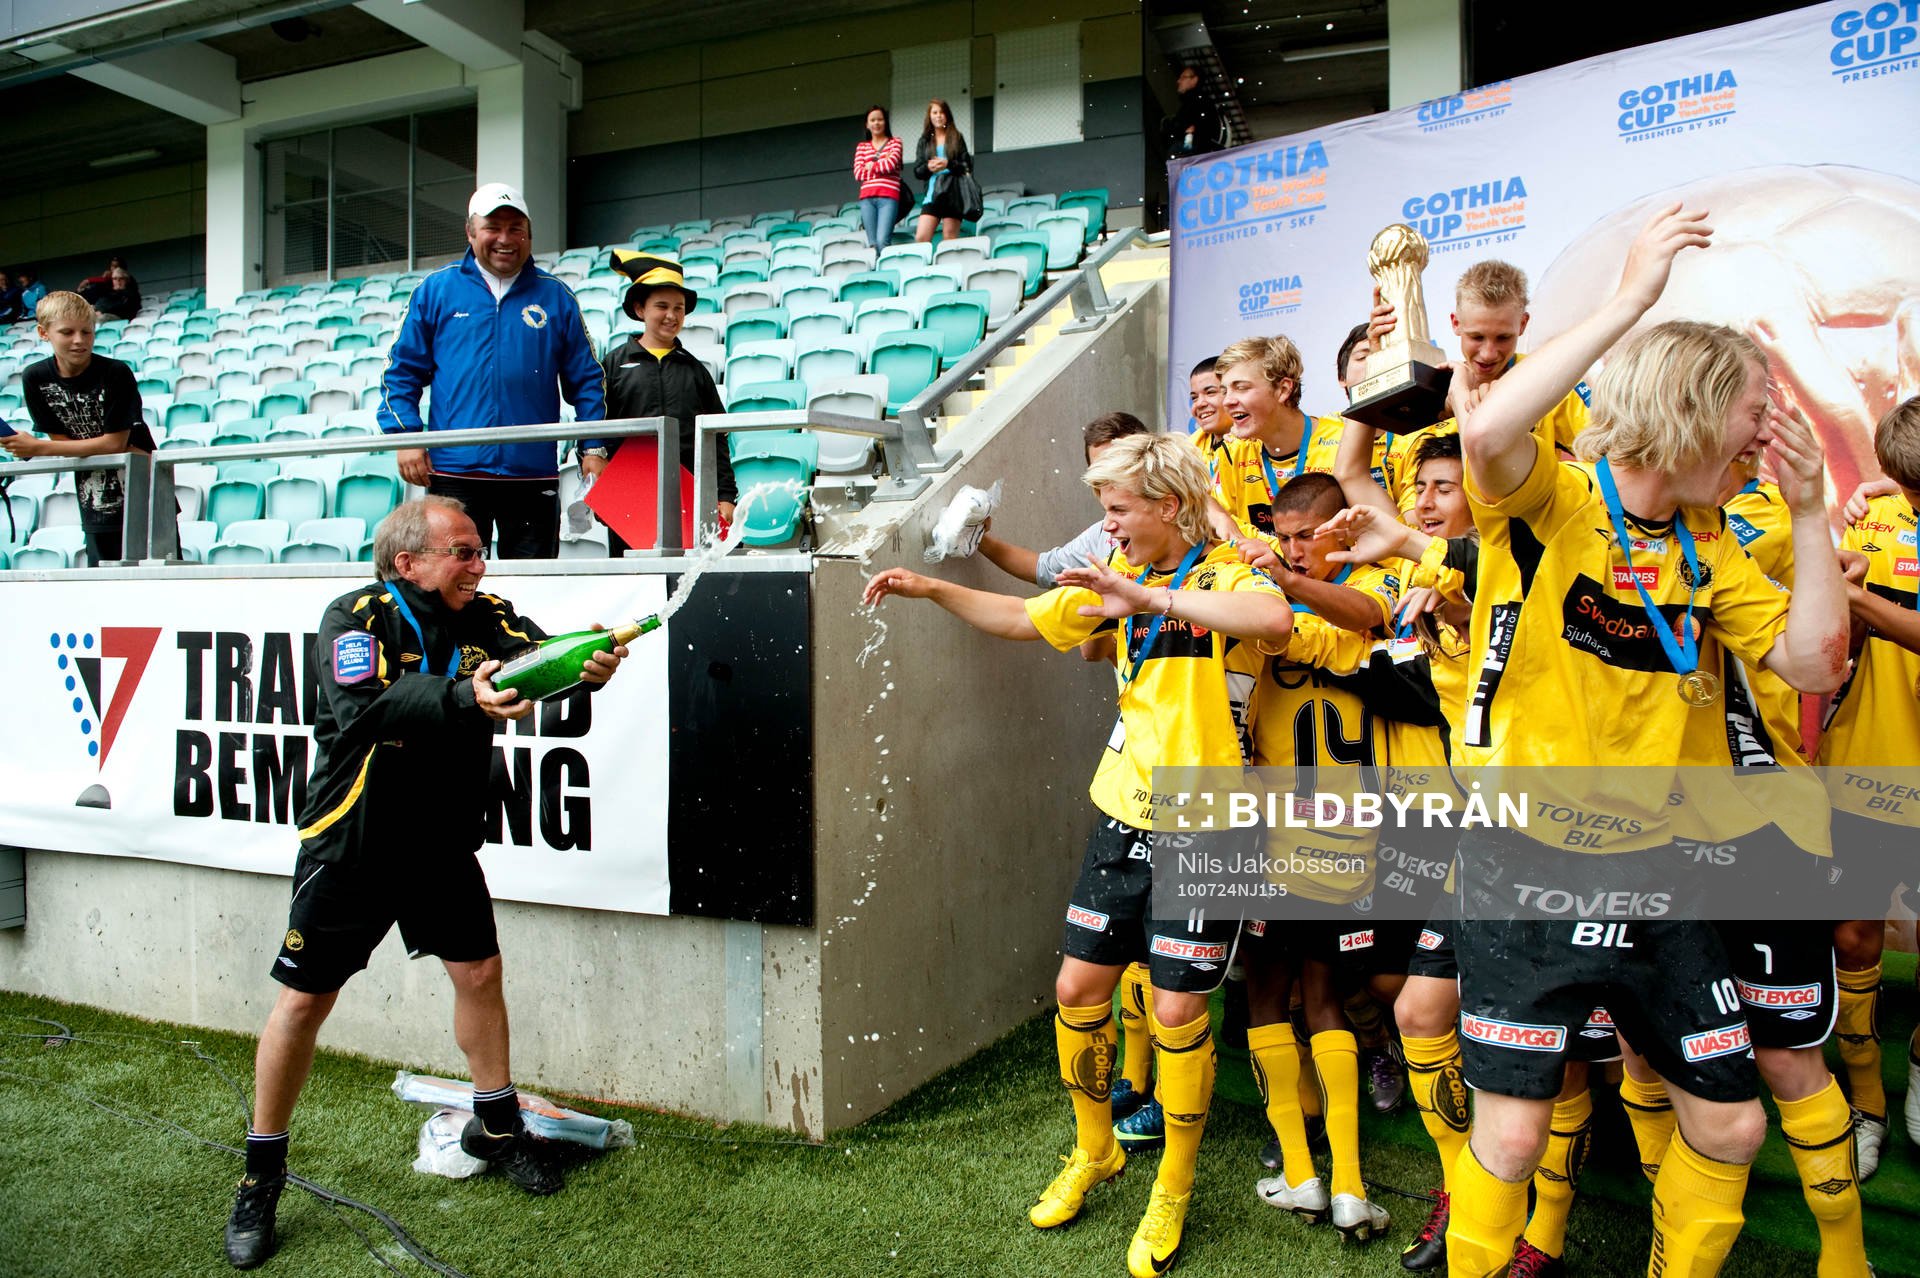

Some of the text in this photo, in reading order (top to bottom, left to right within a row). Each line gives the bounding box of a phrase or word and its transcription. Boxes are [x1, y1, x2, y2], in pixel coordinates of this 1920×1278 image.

[1831, 1, 1920, 38] GOT
[1830, 26, 1918, 67] CUP
[1842, 60, 1919, 84] PRESENTE
[1618, 69, 1737, 110] GOTHIA
[1418, 97, 1464, 122] CUP
[1618, 103, 1676, 131] CUP
[1713, 102, 1735, 111] Cup
[1625, 117, 1728, 144] PRESENTED BY SKF
[1177, 140, 1329, 197] GOTHIA
[1252, 171, 1327, 198] The World
[1297, 191, 1326, 204] Cup
[1402, 176, 1527, 219] GOTHIA
[1178, 189, 1249, 230] CUP
[1465, 211, 1486, 221] The
[1502, 214, 1525, 225] Cup
[1187, 214, 1316, 249] PRESENTED BY SKF
[1408, 214, 1462, 240] UP
[1430, 232, 1518, 255] SENTED BY SKF
[1239, 275, 1303, 298] GOTHIA
[1239, 295, 1269, 312] CUP
[1294, 699, 1381, 800] 14
[1844, 772, 1920, 802] TOVEK
[1536, 801, 1643, 834] TOVEKS
[1866, 796, 1904, 814] BIL
[1563, 829, 1605, 848] BIL
[1382, 871, 1417, 897] BIL
[1513, 883, 1672, 918] TOVEKS
[1069, 908, 1102, 928] -BYGG
[1571, 921, 1634, 948] BIL
[1754, 943, 1773, 975] 7
[1711, 978, 1741, 1015] 10
